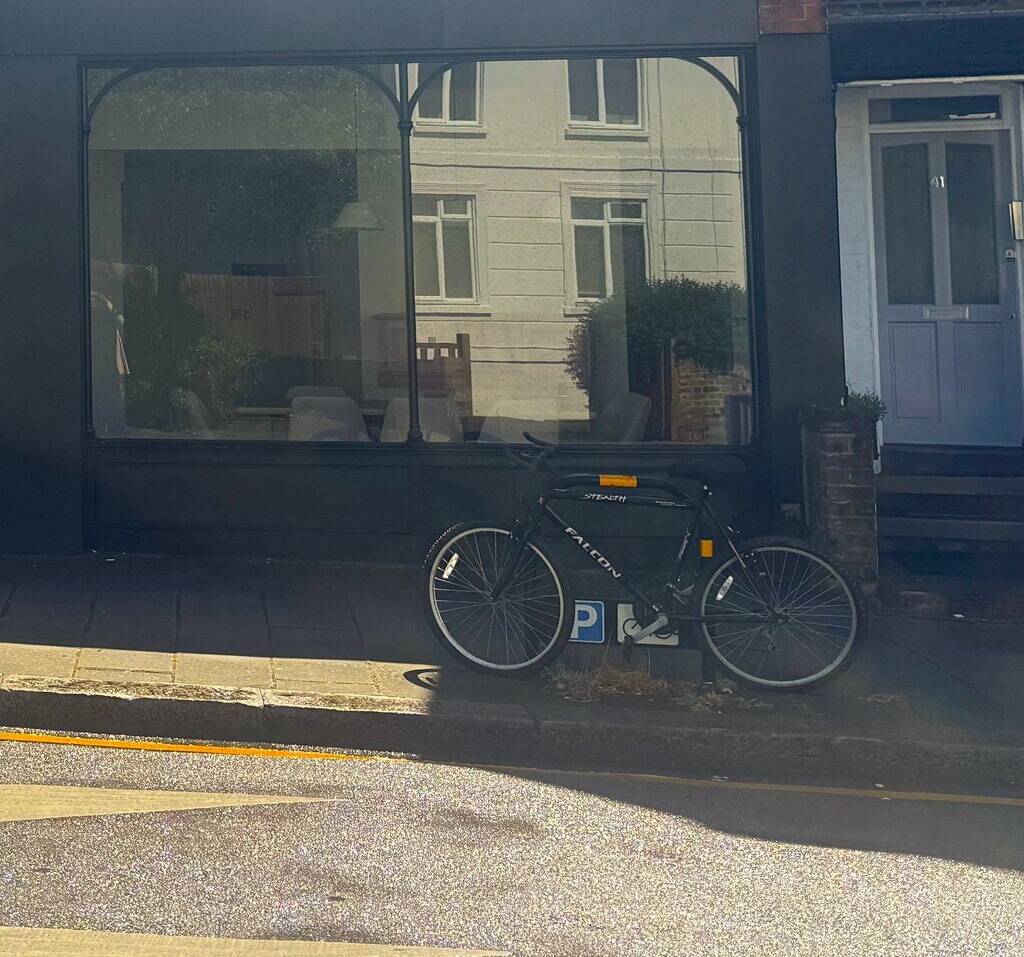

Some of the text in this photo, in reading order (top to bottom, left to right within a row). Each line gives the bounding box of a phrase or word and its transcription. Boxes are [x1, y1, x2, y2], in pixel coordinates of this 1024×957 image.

[930, 175, 945, 188] 41
[584, 493, 626, 503] STEALTH
[564, 526, 622, 579] FALCON
[570, 604, 597, 639] P
